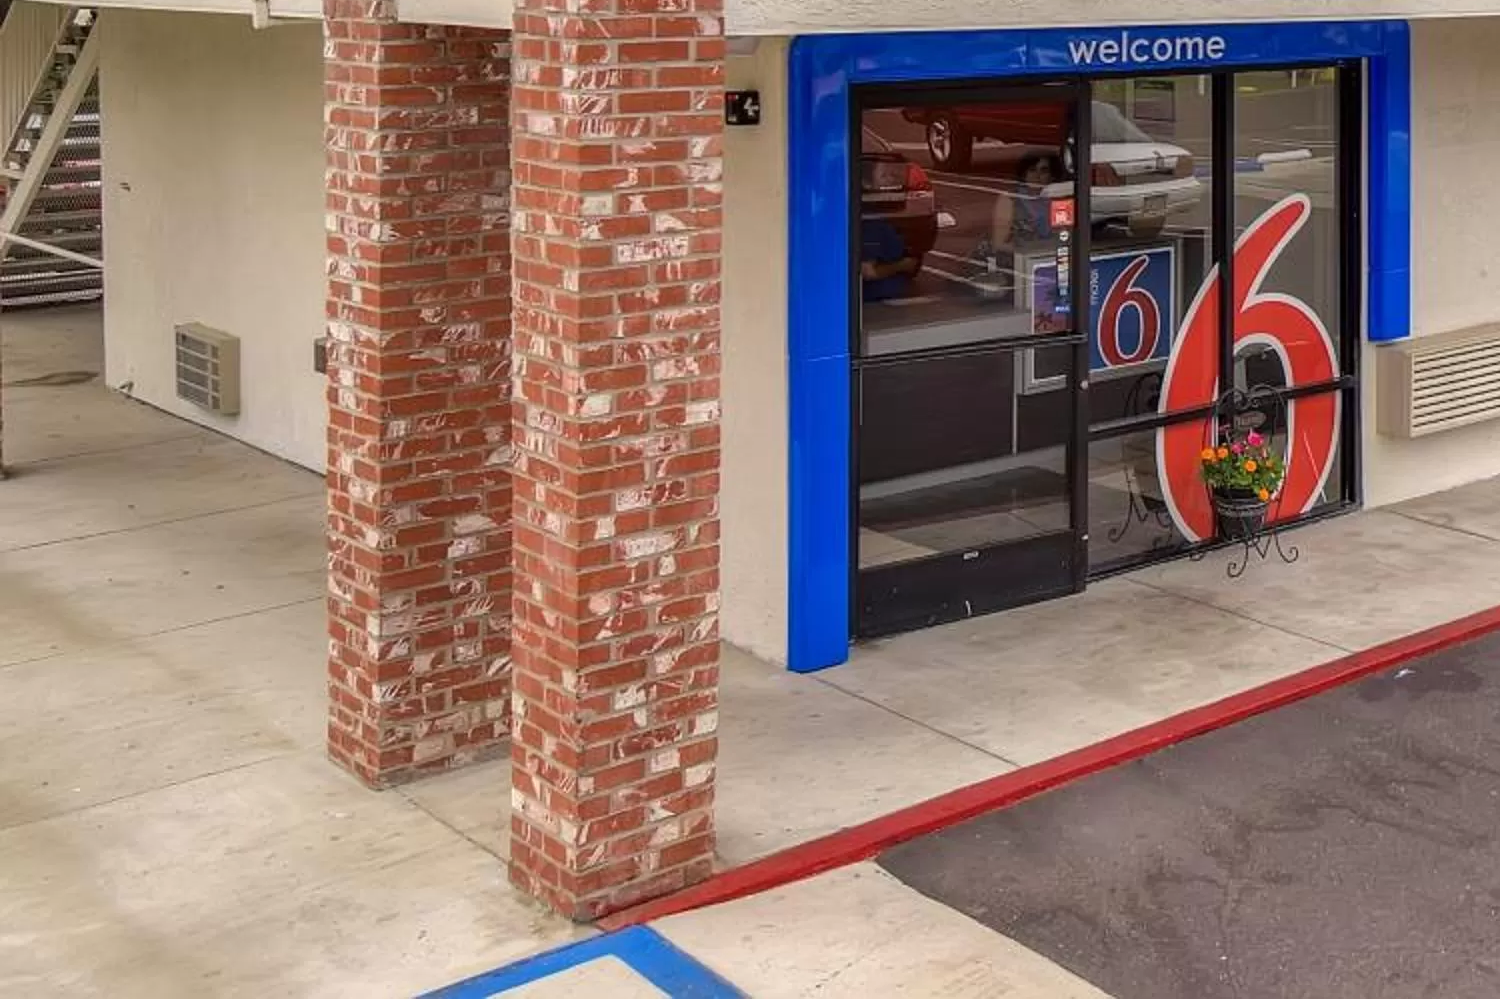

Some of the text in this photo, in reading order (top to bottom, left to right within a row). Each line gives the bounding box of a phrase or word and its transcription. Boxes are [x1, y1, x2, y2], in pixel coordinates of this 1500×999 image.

[1068, 30, 1226, 64] welcome
[1097, 254, 1161, 369] 6
[1155, 192, 1343, 544] 6
